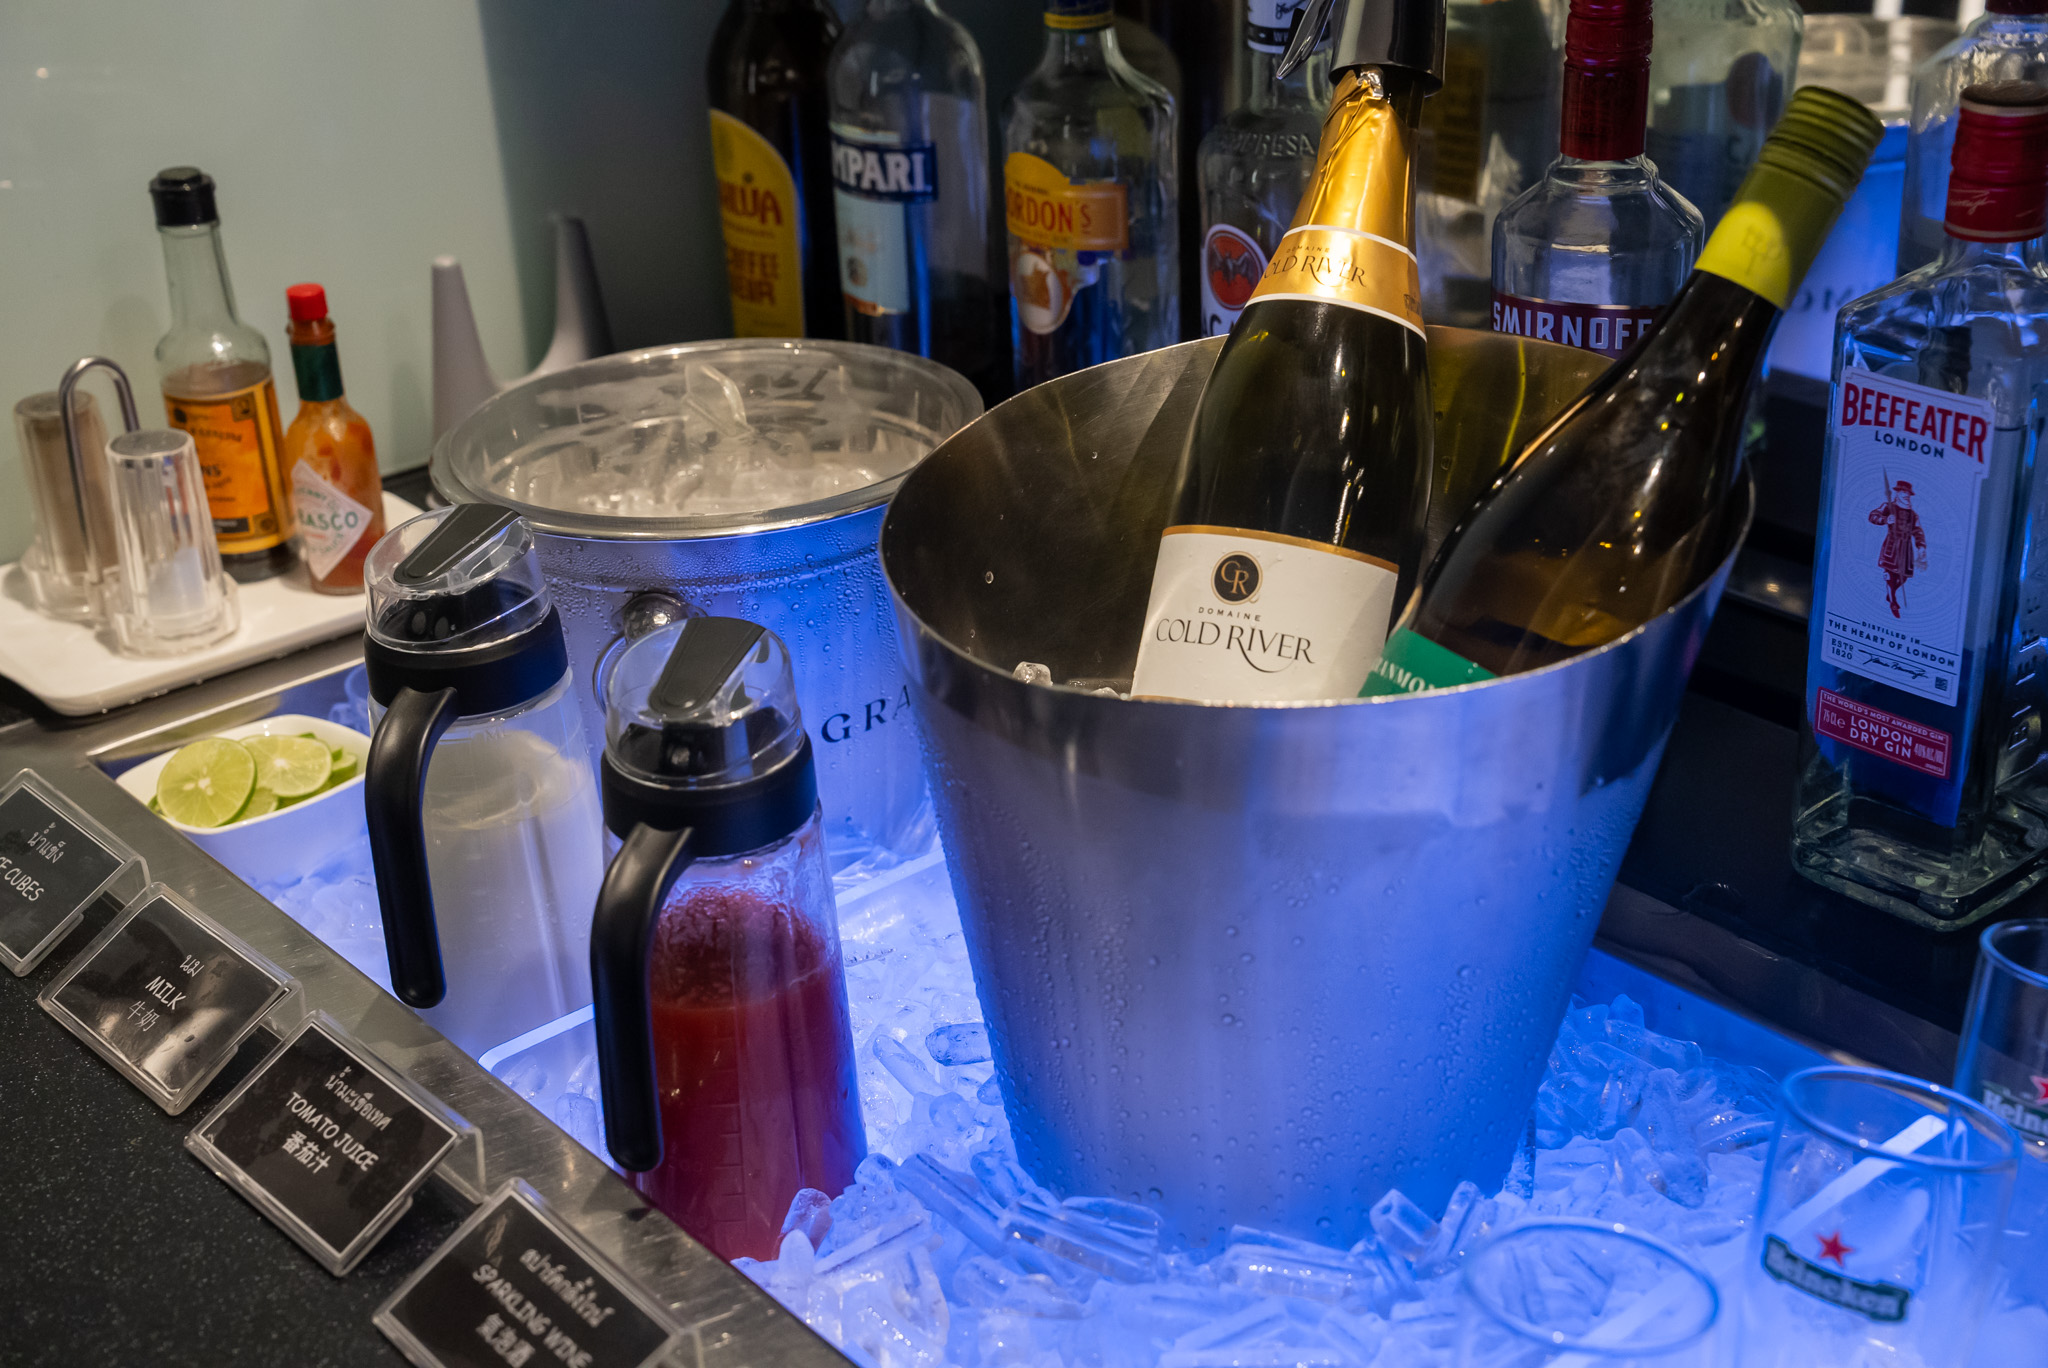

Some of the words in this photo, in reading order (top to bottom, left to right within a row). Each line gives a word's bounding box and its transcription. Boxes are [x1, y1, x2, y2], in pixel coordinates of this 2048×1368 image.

[831, 141, 925, 193] MPARI
[1841, 381, 1988, 464] BEEFEATER
[1875, 430, 1945, 459] LONDON
[1198, 606, 1261, 621] DOMAINE
[1156, 617, 1221, 646] COLD
[1226, 624, 1316, 673] RIVER
[1828, 619, 1847, 632] THE
[1851, 627, 1884, 645] HEART
[1888, 640, 1903, 650] OF
[1906, 647, 1955, 668] LONDON
[1862, 620, 1907, 641] DISTILLED
[1910, 636, 1921, 645] IN
[1831, 646, 1853, 660] 1820
[1823, 693, 1836, 703] THE
[1837, 698, 1869, 715] WORLD'S
[1869, 711, 1890, 723] MOST
[1891, 719, 1928, 736] AWARDED
[1929, 732, 1945, 742] GIN
[1850, 715, 1912, 747] LONDON
[1850, 728, 1879, 746] DRY
[1884, 741, 1912, 758] GIN
[4, 868, 45, 901] CUBES
[180, 954, 204, 978] นม
[145, 976, 187, 1010] MILK
[127, 1000, 160, 1032] 牛奶
[285, 1091, 340, 1140] TOMATO
[333, 1132, 380, 1172] JUICE
[282, 1130, 331, 1174] 番茄汁
